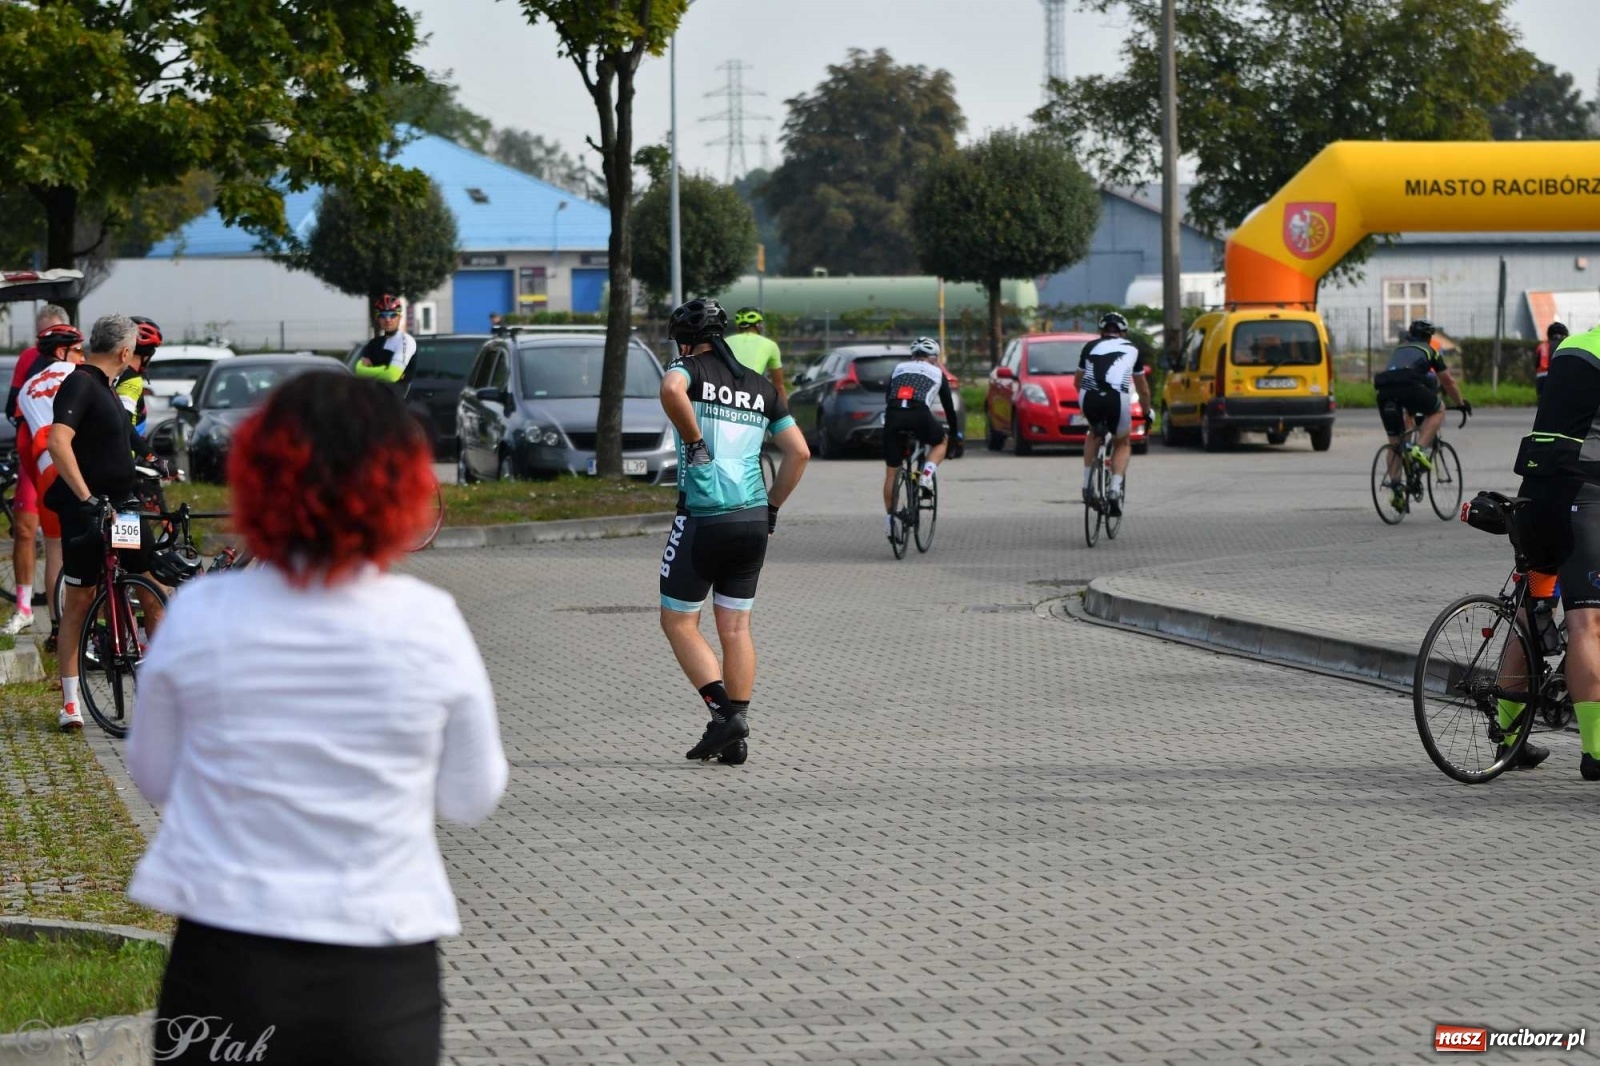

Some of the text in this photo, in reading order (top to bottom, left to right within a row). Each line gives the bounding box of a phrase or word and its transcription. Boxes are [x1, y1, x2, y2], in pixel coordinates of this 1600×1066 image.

[1405, 175, 1600, 196] MIASTO RACIBÓRZ
[702, 381, 765, 413] BORA
[705, 403, 762, 424] hansgrohe
[114, 525, 139, 536] 1506
[660, 515, 687, 578] BORA
